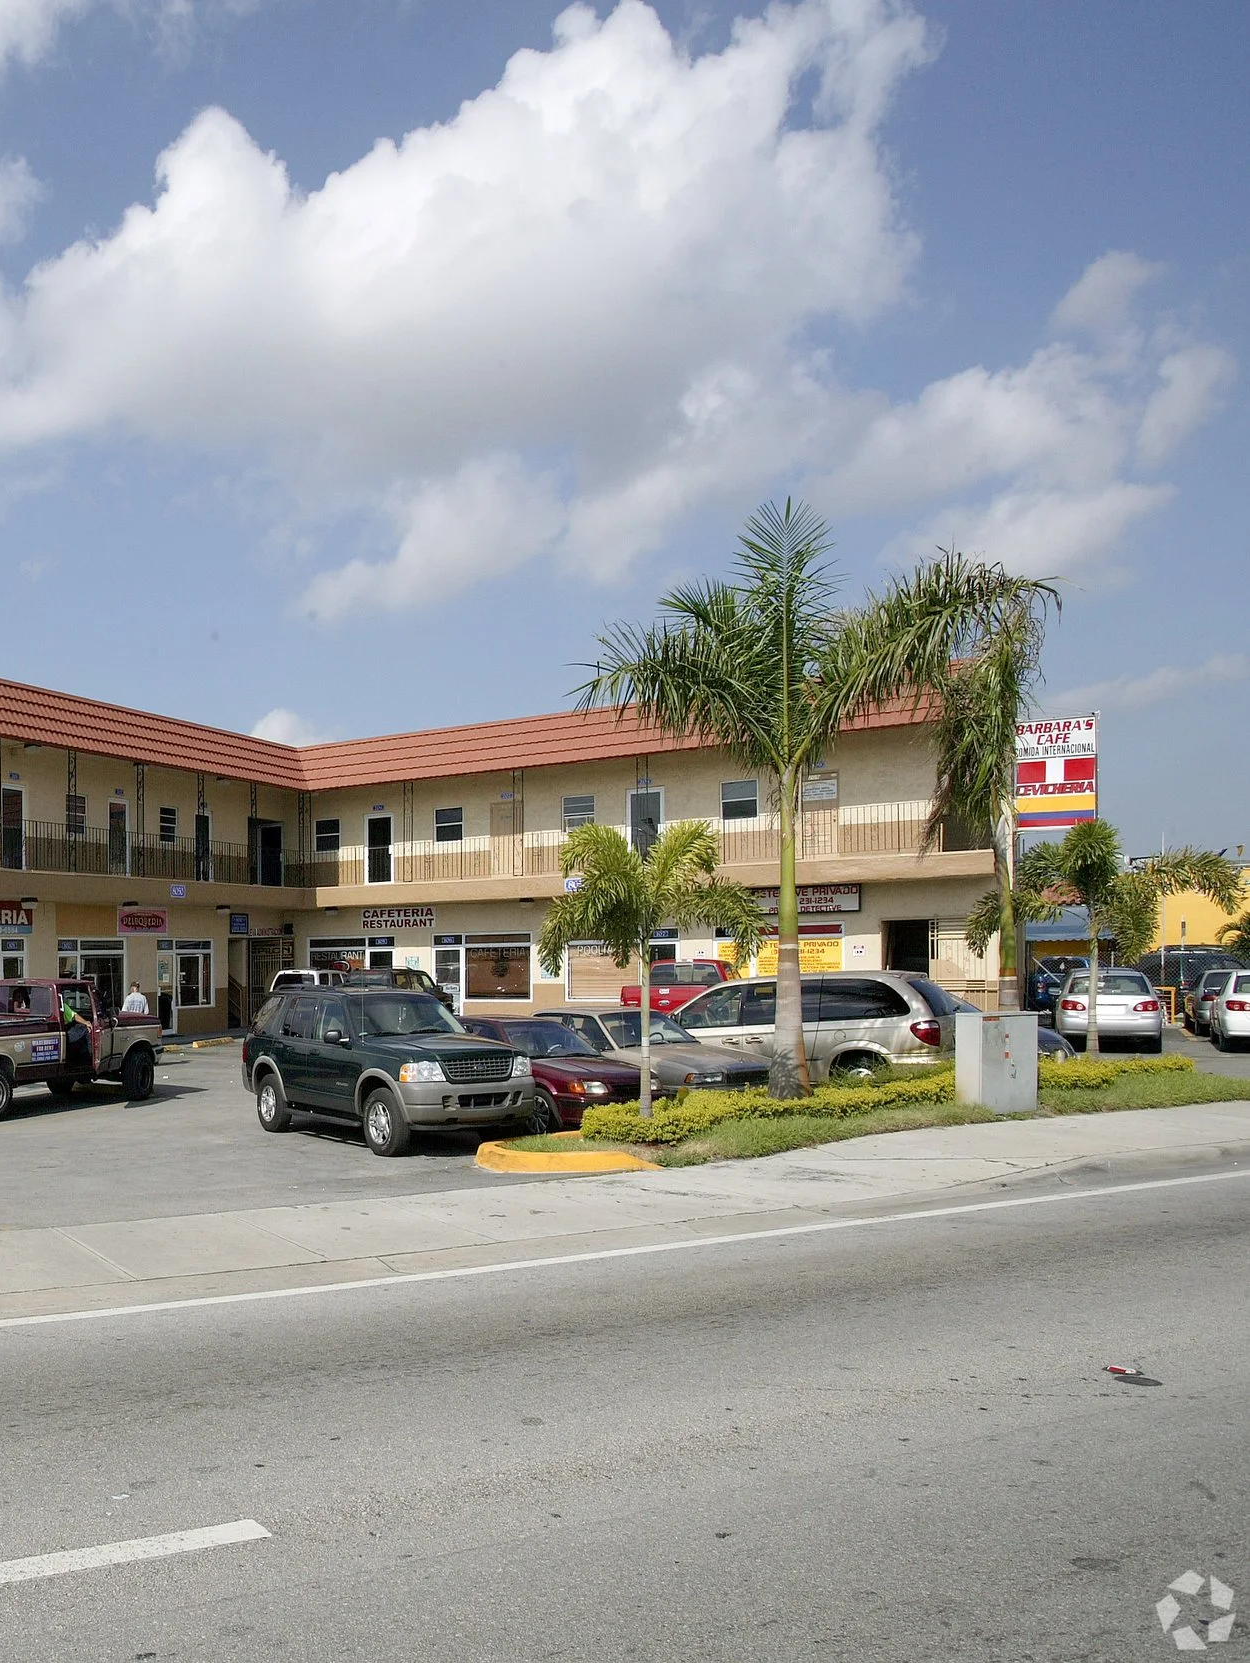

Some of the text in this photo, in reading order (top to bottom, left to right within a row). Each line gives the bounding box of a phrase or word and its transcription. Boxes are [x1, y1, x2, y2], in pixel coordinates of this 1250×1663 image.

[1015, 719, 1094, 735] BARBARA'S
[1036, 732, 1071, 746] CAFE
[1042, 742, 1095, 756] INTERNACIONAL
[1016, 781, 1095, 797] CEVICHERIA
[753, 885, 858, 898] DETEVE PRIVADO
[362, 907, 434, 919] CAFETERIA
[800, 904, 842, 912] DETECTIVE
[362, 918, 435, 929] RESTAURANT
[311, 951, 365, 961] RESTAURANT
[470, 947, 529, 959] CAFETERIA
